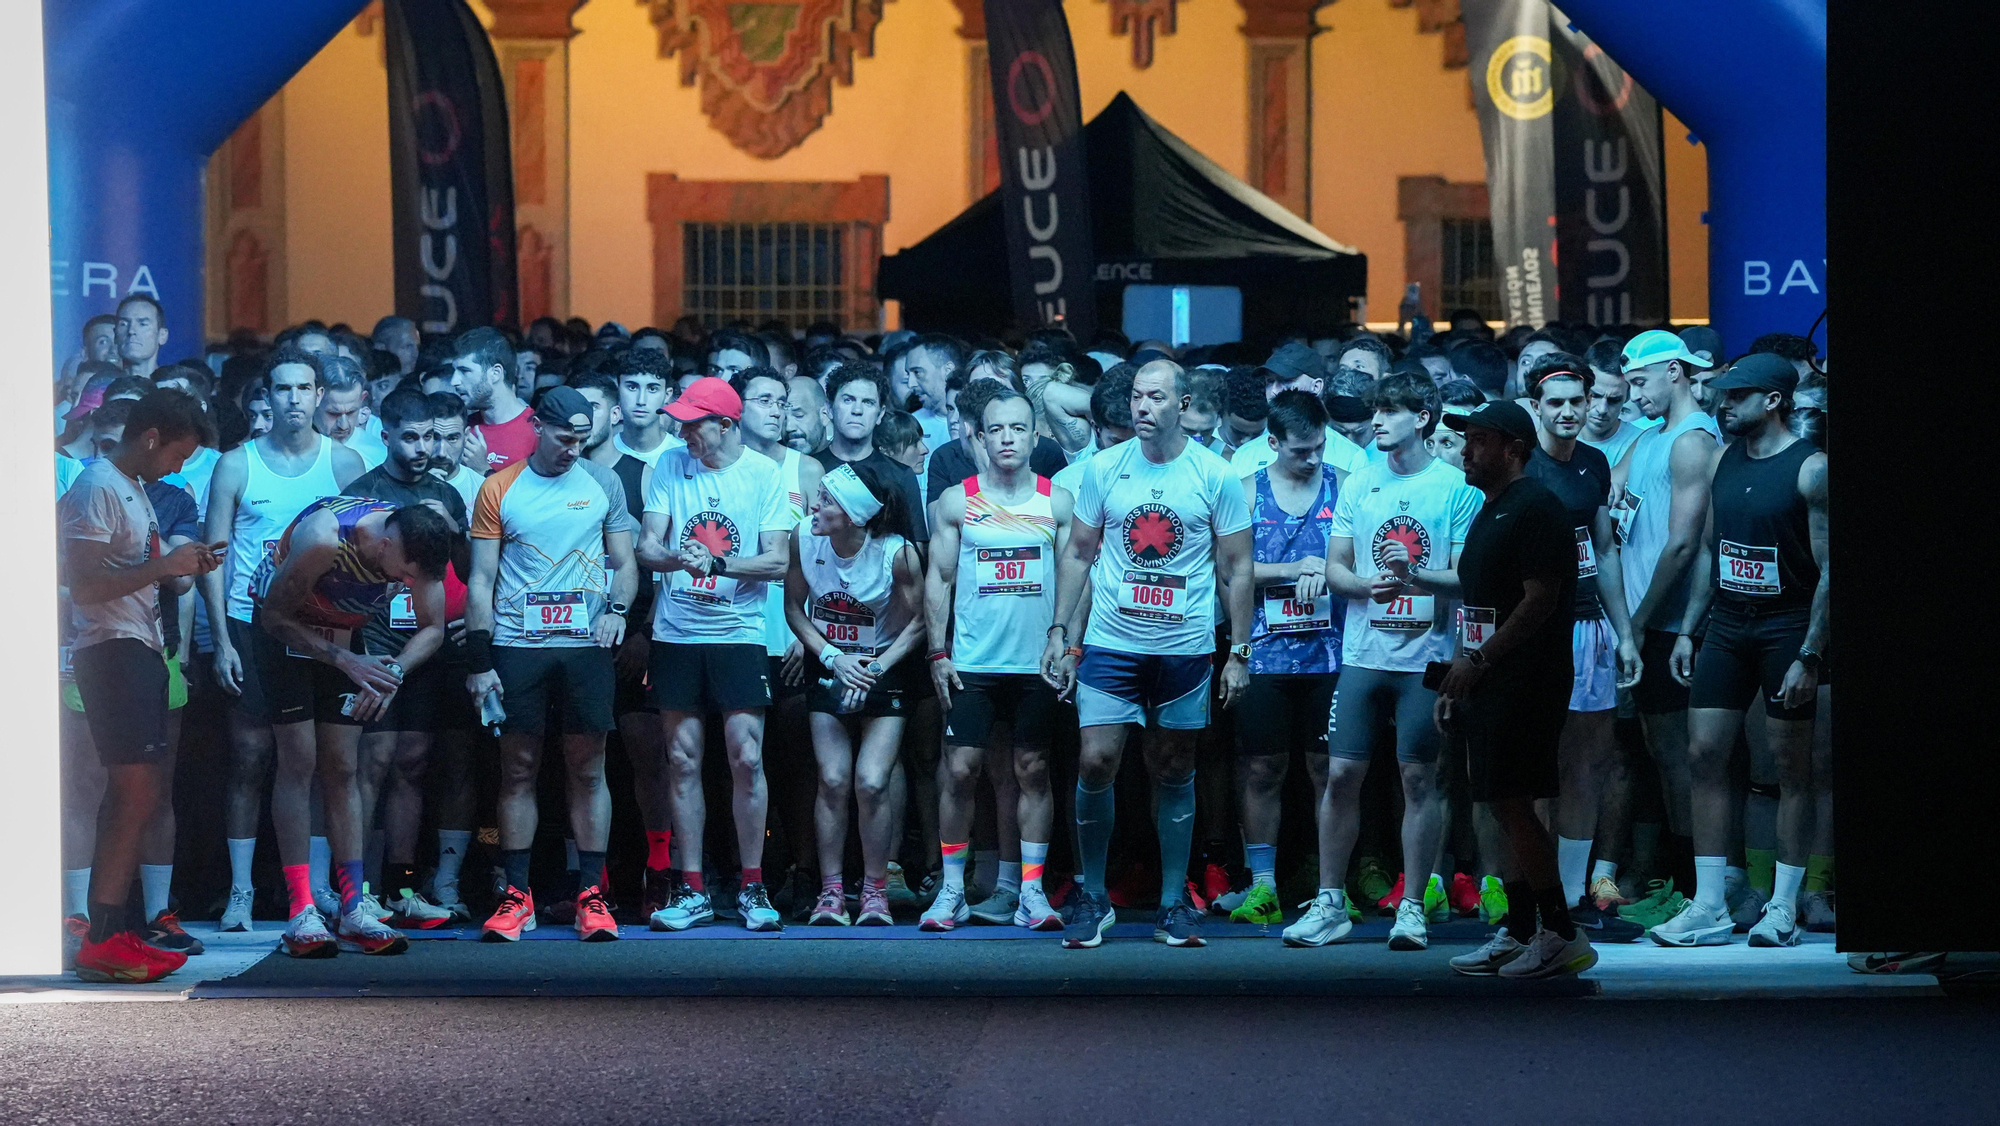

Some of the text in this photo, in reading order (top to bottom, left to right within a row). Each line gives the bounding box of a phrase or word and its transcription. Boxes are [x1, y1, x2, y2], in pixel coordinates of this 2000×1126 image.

[1744, 259, 1827, 295] BA
[1142, 503, 1168, 515] RUN
[701, 512, 724, 522] RUN
[723, 520, 740, 550] ROCK
[1123, 508, 1141, 560] RUNNERS
[1166, 510, 1183, 542] ROCK
[1393, 516, 1414, 526] RUN
[1413, 523, 1430, 554] ROCK
[1136, 543, 1181, 569] RUNNING
[995, 561, 1026, 580] 367
[1729, 558, 1765, 580] 1252
[833, 592, 853, 604] RUN
[1131, 585, 1173, 607] 1069
[1386, 596, 1412, 615] 271
[541, 605, 572, 624] 922
[826, 623, 858, 641] 803
